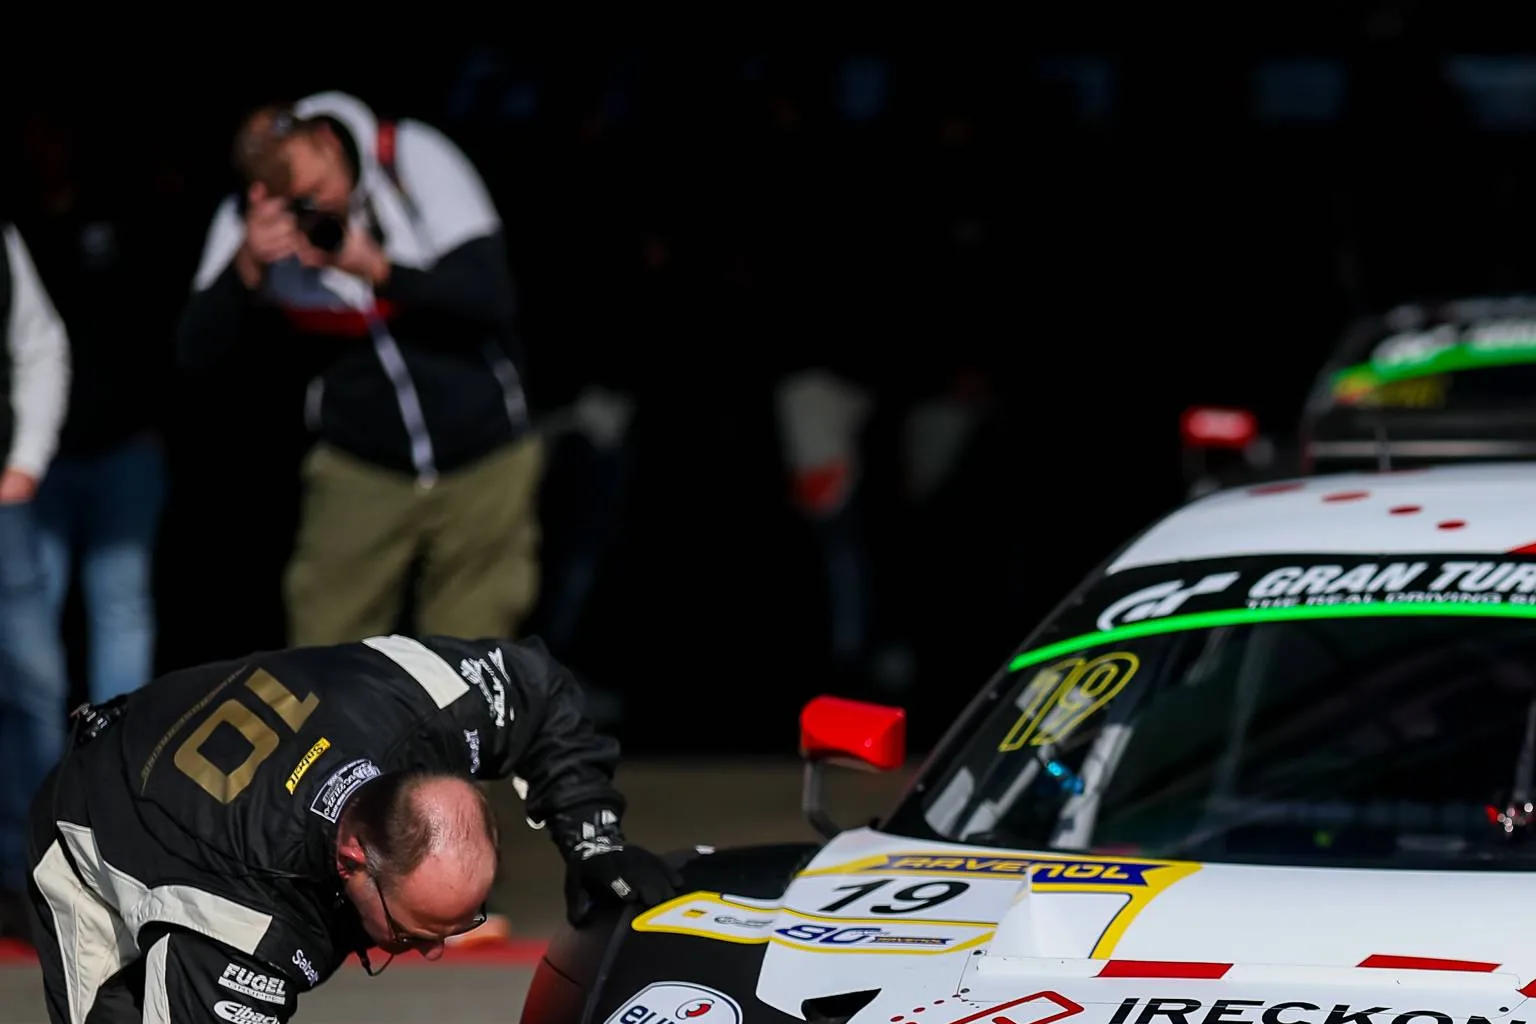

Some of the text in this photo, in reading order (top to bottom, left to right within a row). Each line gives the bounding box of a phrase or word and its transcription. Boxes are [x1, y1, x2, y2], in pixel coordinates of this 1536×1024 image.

[1249, 562, 1428, 600] GRAN
[998, 652, 1141, 752] 19
[818, 879, 970, 915] 19
[222, 962, 286, 996] FUGEL
